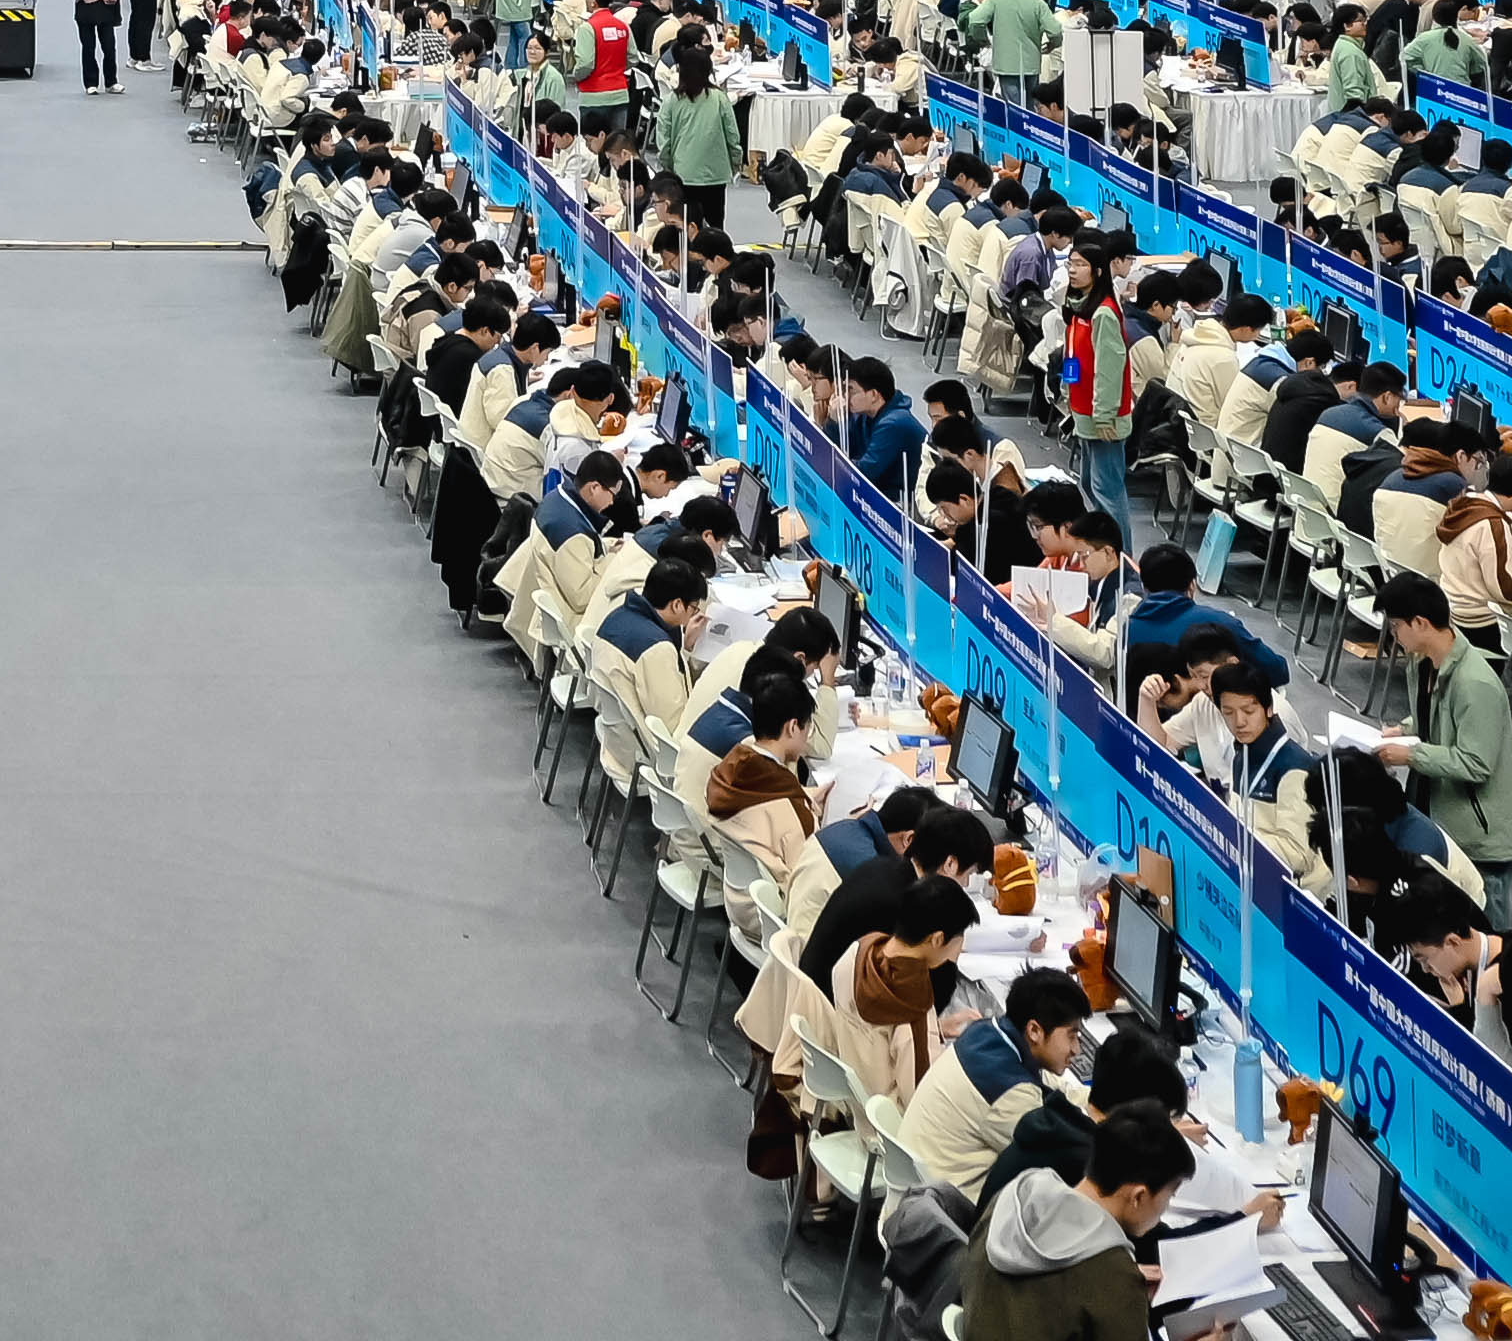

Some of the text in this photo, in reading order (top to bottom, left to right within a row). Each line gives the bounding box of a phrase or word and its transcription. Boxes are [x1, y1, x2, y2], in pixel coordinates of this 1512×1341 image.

[844, 522, 874, 595] D08
[966, 636, 1007, 707] D09
[1317, 999, 1397, 1138] D69
